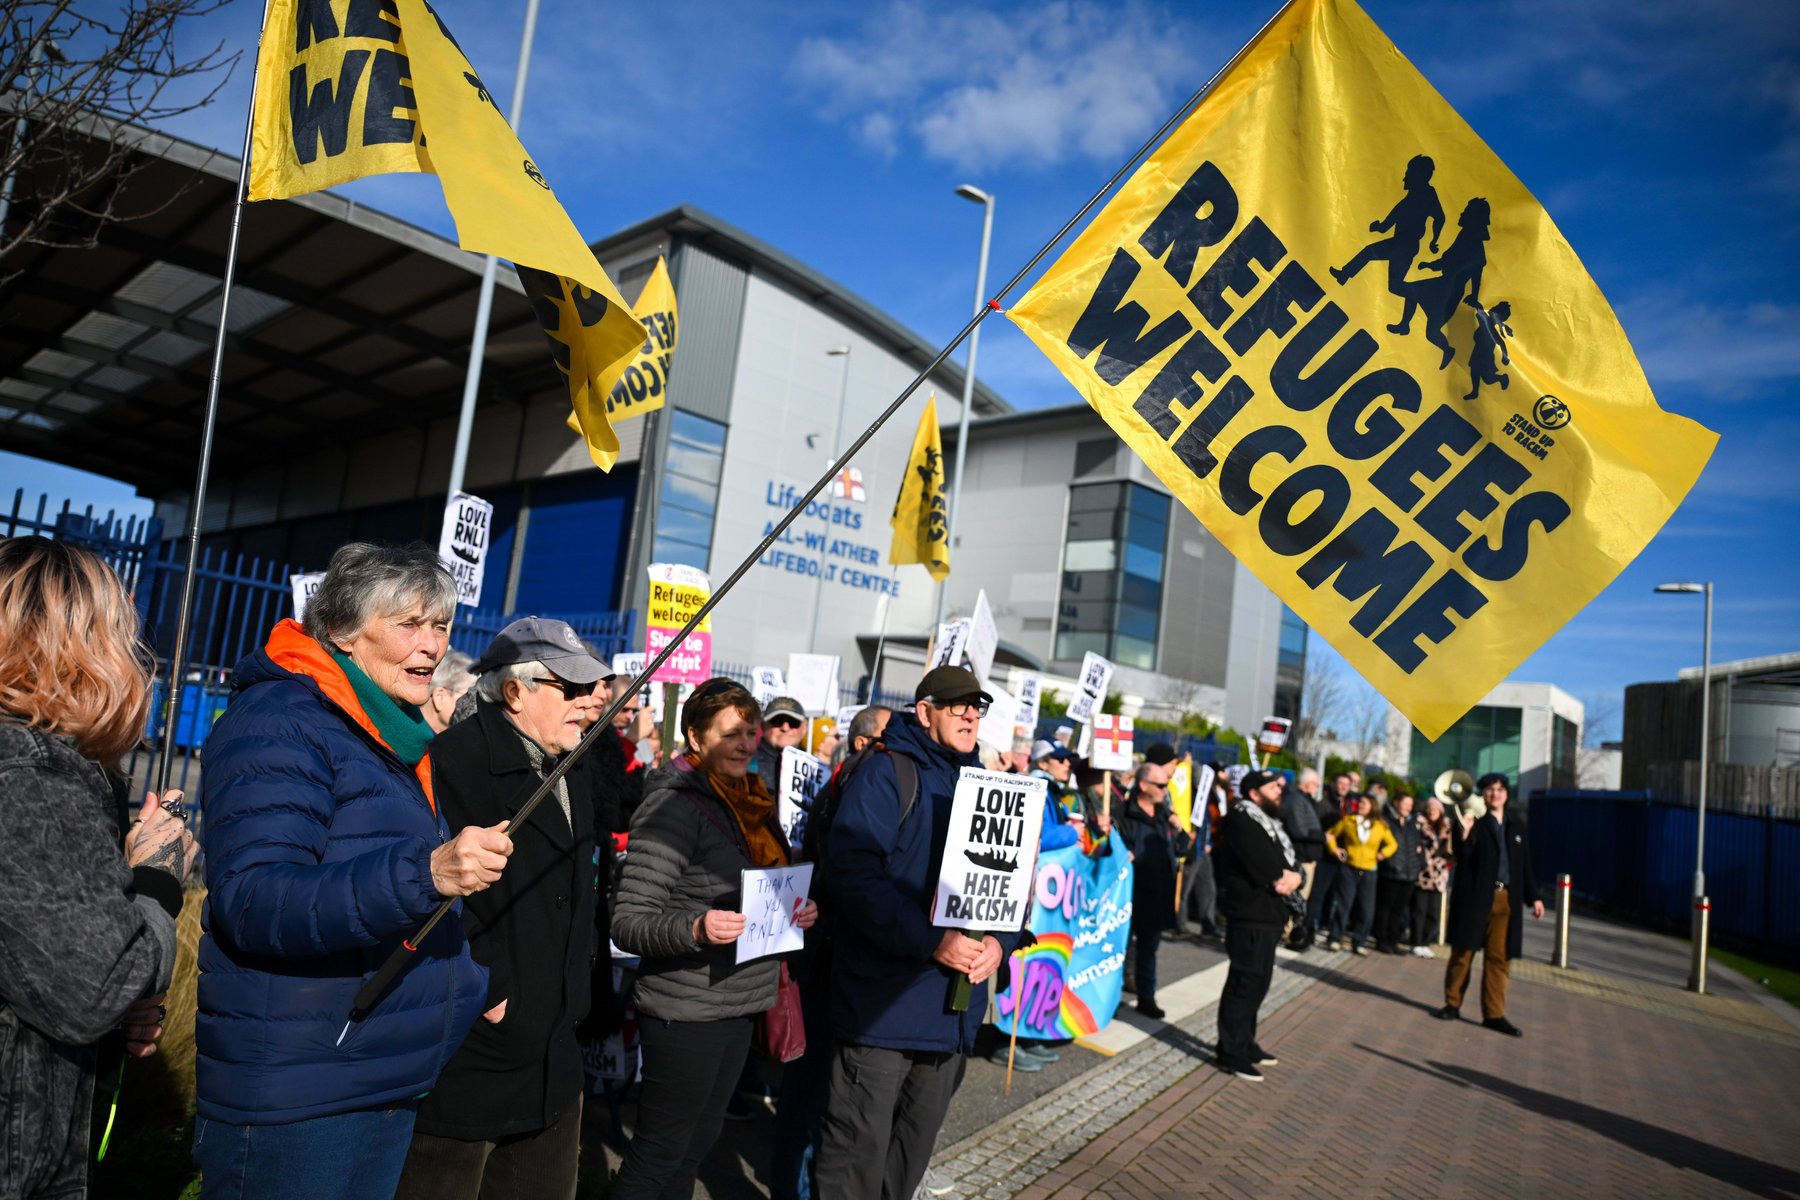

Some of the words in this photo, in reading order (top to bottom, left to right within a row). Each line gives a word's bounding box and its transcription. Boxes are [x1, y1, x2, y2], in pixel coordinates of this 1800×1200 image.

[290, 48, 426, 165] WE
[1138, 160, 1571, 581] REFUGEES
[1502, 422, 1516, 435] TO
[1510, 413, 1540, 438] STAND
[1539, 434, 1555, 447] UP
[1067, 246, 1489, 674] WELCOME
[458, 503, 487, 529] LOVE
[454, 521, 485, 549] RNLI
[653, 607, 704, 626] welco
[624, 660, 645, 671] LOV
[794, 759, 823, 785] LOVE
[975, 786, 1026, 817] LOVE
[968, 813, 1024, 847] RNLI
[757, 874, 794, 894] THANK
[963, 872, 1011, 898] HATE
[945, 894, 1018, 922] RACISM
[747, 915, 787, 943] RNLI
